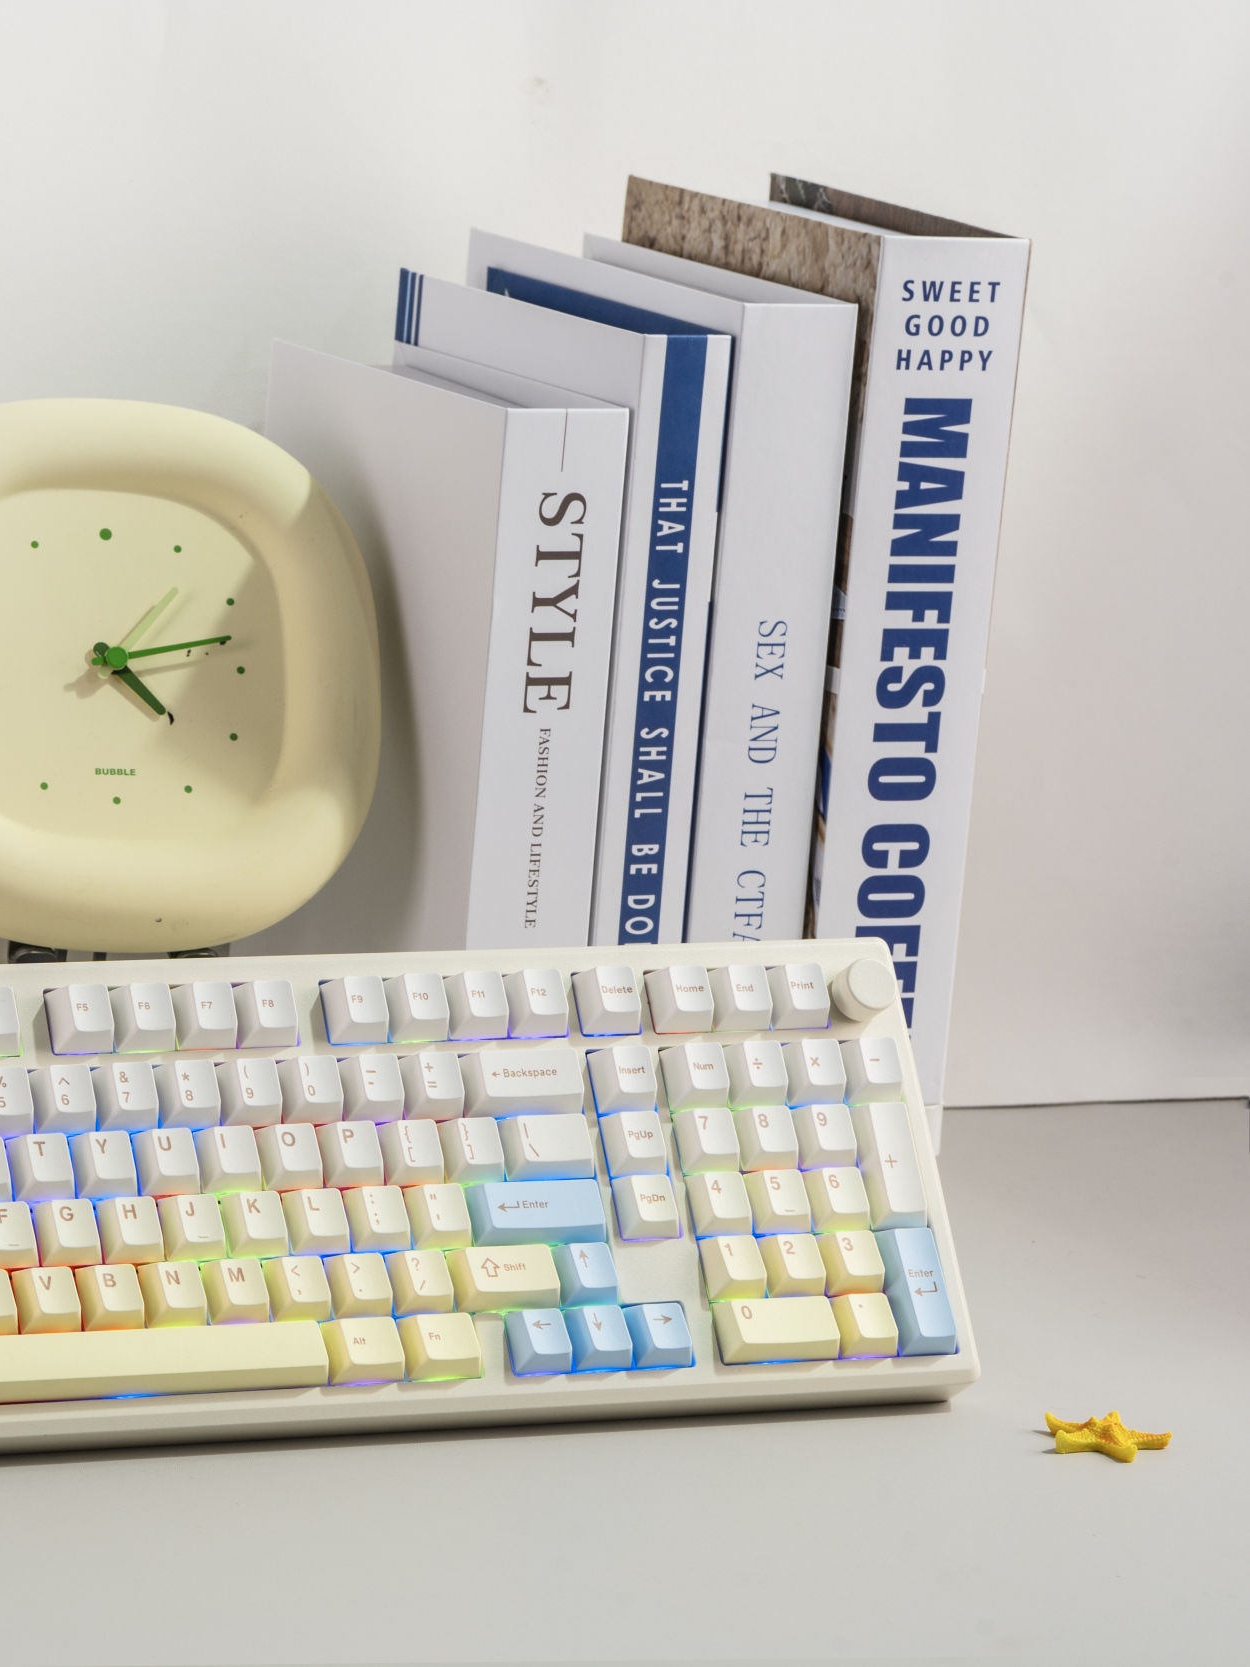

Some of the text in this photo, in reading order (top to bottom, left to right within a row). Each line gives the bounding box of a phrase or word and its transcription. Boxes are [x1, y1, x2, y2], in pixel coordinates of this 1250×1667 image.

[901, 280, 1002, 303] SWEET
[904, 314, 991, 338] GOOD
[896, 348, 994, 372] HAPPY
[656, 480, 689, 554] THAT
[522, 491, 587, 714] STYLE
[867, 397, 972, 801] MANIFESTO
[644, 579, 680, 702] JUSTICE
[755, 620, 788, 680] SEX
[747, 703, 781, 764] AND
[95, 768, 136, 776] BUBBLE
[634, 727, 670, 818] SHALL
[740, 787, 774, 847] THE
[524, 728, 551, 928] FASHION AND LIFESTYLE
[630, 844, 660, 874] BE
[531, 988, 546, 996] F12
[602, 985, 632, 994] Delete
[676, 984, 704, 993] Home
[736, 984, 753, 992] End
[791, 982, 814, 990] Print
[351, 995, 363, 1003] F9
[413, 993, 428, 1001] F10
[471, 990, 485, 999] F11
[76, 1003, 88, 1011] F5
[138, 1002, 150, 1010] F6
[201, 1002, 212, 1010] F7
[262, 1000, 274, 1008] F8
[244, 1065, 248, 1078] (
[305, 1063, 309, 1076] )
[425, 1063, 433, 1072] +
[619, 1065, 645, 1074] Insert
[693, 1062, 714, 1070] Num
[120, 1072, 129, 1083] &
[503, 1068, 557, 1078] Backspace
[185, 1090, 193, 1101] 8
[246, 1088, 254, 1098] 9
[308, 1085, 315, 1096] 0
[61, 1094, 69, 1106] 6
[122, 1092, 130, 1103] 7
[698, 1116, 708, 1130] 7
[758, 1114, 769, 1128] 8
[816, 1112, 827, 1126] 9
[342, 1129, 354, 1143] P
[404, 1126, 411, 1143] {
[461, 1123, 468, 1141] }
[628, 1130, 653, 1140] PgUp
[158, 1136, 171, 1151] U
[281, 1132, 295, 1147] O
[33, 1141, 45, 1156] T
[96, 1139, 107, 1154] Y
[467, 1144, 474, 1159] ]
[529, 1143, 539, 1157] \
[408, 1147, 416, 1162] [
[885, 1154, 897, 1168] +
[711, 1180, 722, 1194] 4
[770, 1176, 780, 1190] 5
[828, 1174, 839, 1188] 6
[307, 1196, 320, 1211] L
[522, 1200, 548, 1209] Enter
[640, 1193, 666, 1204] PgDn
[122, 1204, 137, 1220] H
[186, 1202, 195, 1216] J
[247, 1199, 260, 1213] K
[60, 1206, 74, 1221] G
[724, 1243, 733, 1256] 1
[784, 1241, 795, 1254] 2
[843, 1238, 854, 1251] 3
[291, 1265, 300, 1276] <
[351, 1263, 360, 1273] >
[411, 1258, 420, 1271] ?
[504, 1262, 526, 1272] Shift
[103, 1273, 116, 1287] B
[165, 1270, 180, 1285] N
[228, 1268, 245, 1282] M
[908, 1269, 934, 1278] Enter
[39, 1276, 52, 1290] V
[420, 1280, 426, 1290] /
[741, 1306, 752, 1319] 0
[353, 1337, 366, 1345] Alt
[429, 1332, 441, 1340] Fn
